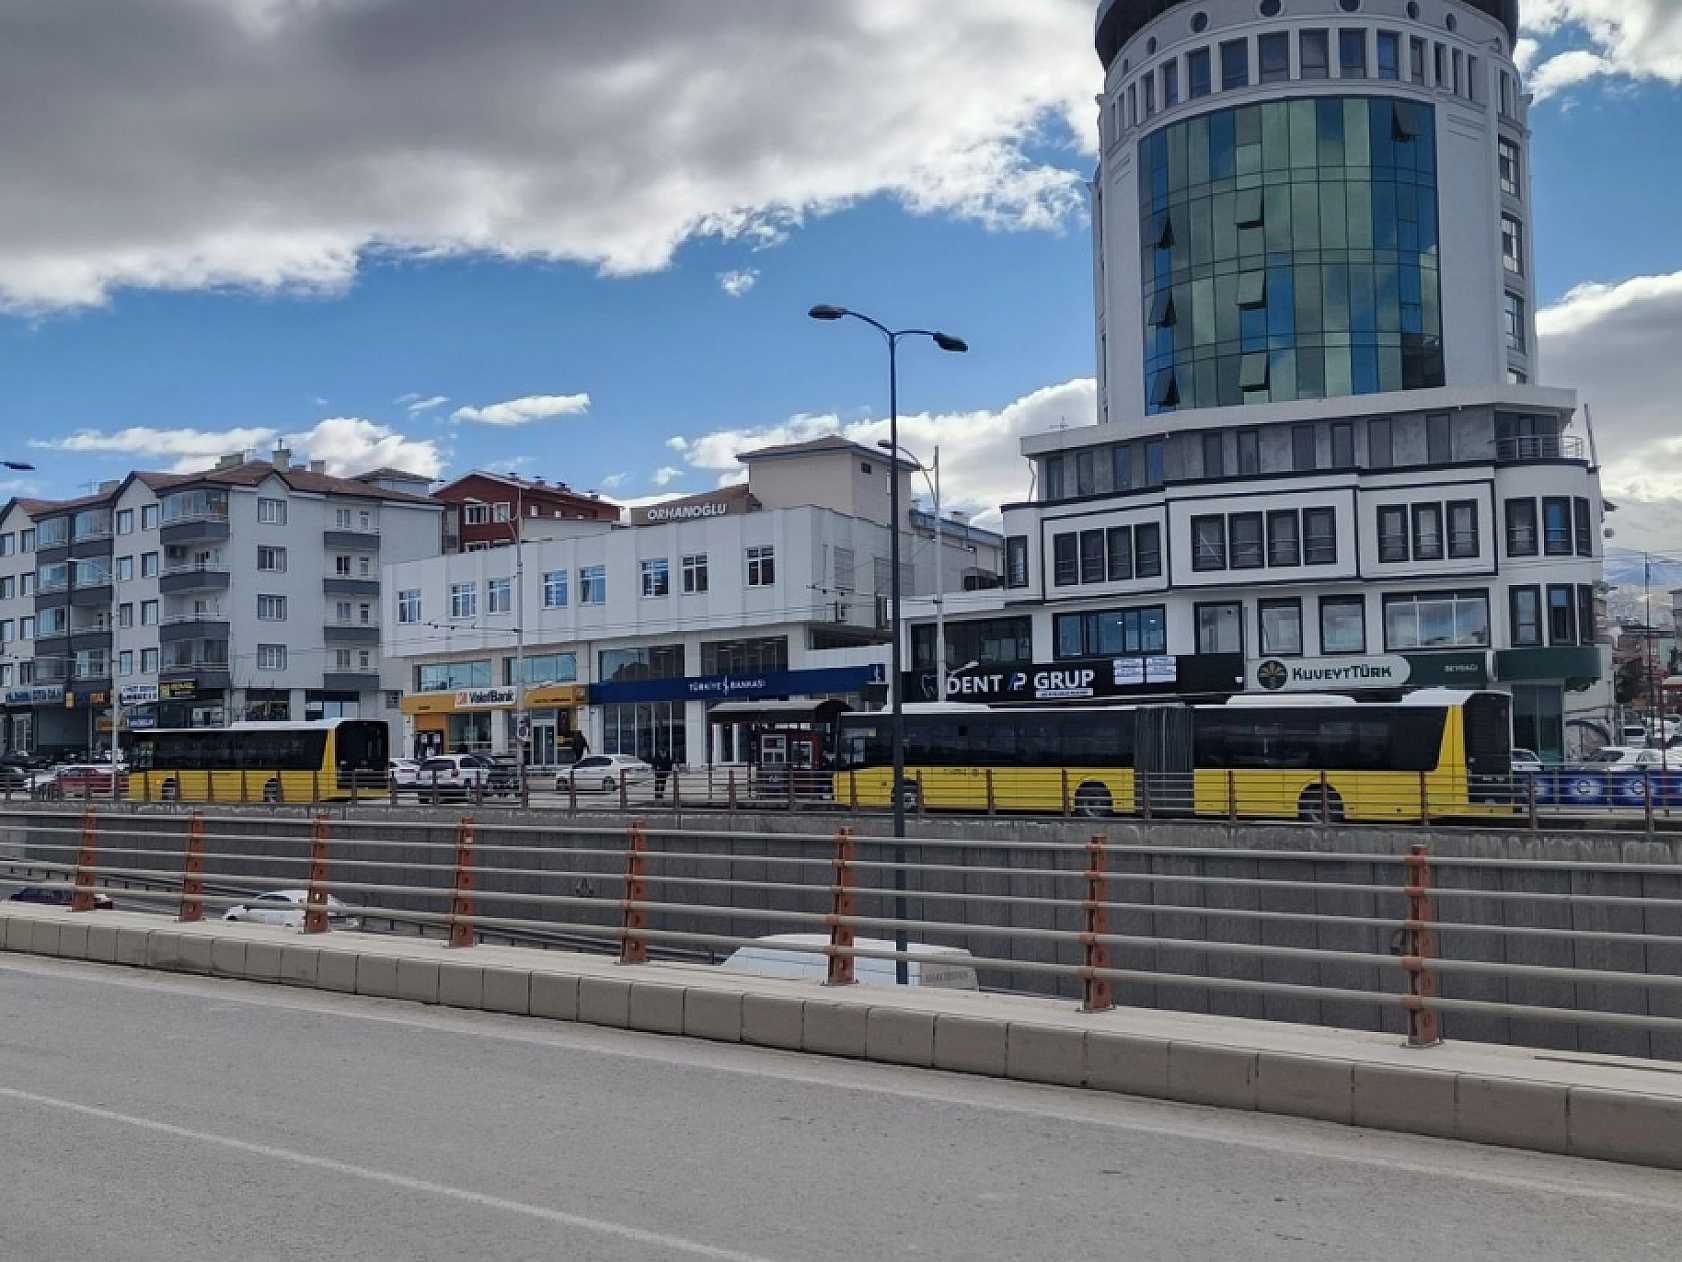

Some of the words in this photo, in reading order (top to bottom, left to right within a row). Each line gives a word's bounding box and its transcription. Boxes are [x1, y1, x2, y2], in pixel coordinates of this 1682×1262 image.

[648, 502, 727, 520] ORHANOĞLU
[947, 674, 1003, 695] DENT
[1033, 669, 1095, 690] GRUP
